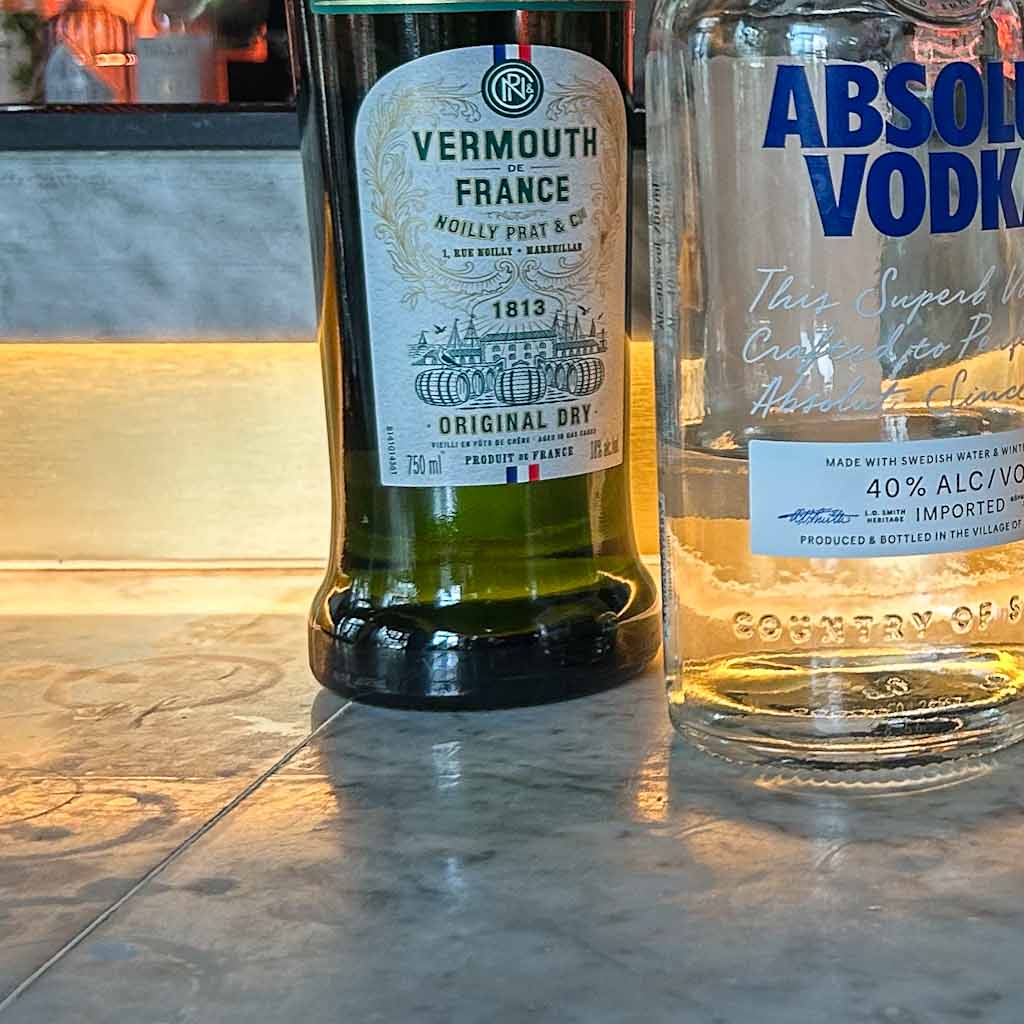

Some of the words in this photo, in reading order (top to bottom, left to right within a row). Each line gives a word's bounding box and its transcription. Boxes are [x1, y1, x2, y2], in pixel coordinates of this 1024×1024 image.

[412, 127, 598, 161] VERMOUTH
[507, 164, 524, 173] DE
[456, 176, 570, 206] FRANCE
[435, 214, 499, 240] NOILLY
[507, 223, 548, 240] PRAT
[554, 220, 565, 233] &
[454, 248, 474, 258] RUE
[478, 247, 513, 257] NOILLY
[748, 265, 841, 315] This
[855, 264, 996, 324] Superb
[492, 299, 546, 319] 1813
[439, 410, 547, 435] ORIGINAL
[557, 404, 591, 427] DRY
[406, 454, 426, 475] 750
[428, 454, 442, 475] ml
[465, 452, 515, 465] PRODUIT
[532, 446, 574, 462] FRANCE
[825, 457, 862, 468] MADE
[865, 457, 898, 467] WITH
[901, 453, 953, 465] SWEDISH
[956, 449, 991, 462] WATER
[993, 447, 999, 457] &
[866, 475, 926, 499] 40%
[916, 497, 1006, 522] IMPORTED
[800, 535, 866, 545] PRODUCED
[869, 536, 876, 545] &
[880, 532, 932, 545] BOTTLED
[935, 531, 947, 541] IN
[951, 528, 970, 539] THE
[972, 521, 1010, 536] VILLAGE
[1012, 519, 1022, 529] OF
[734, 610, 933, 644] COUNTRY
[951, 601, 993, 635] OF
